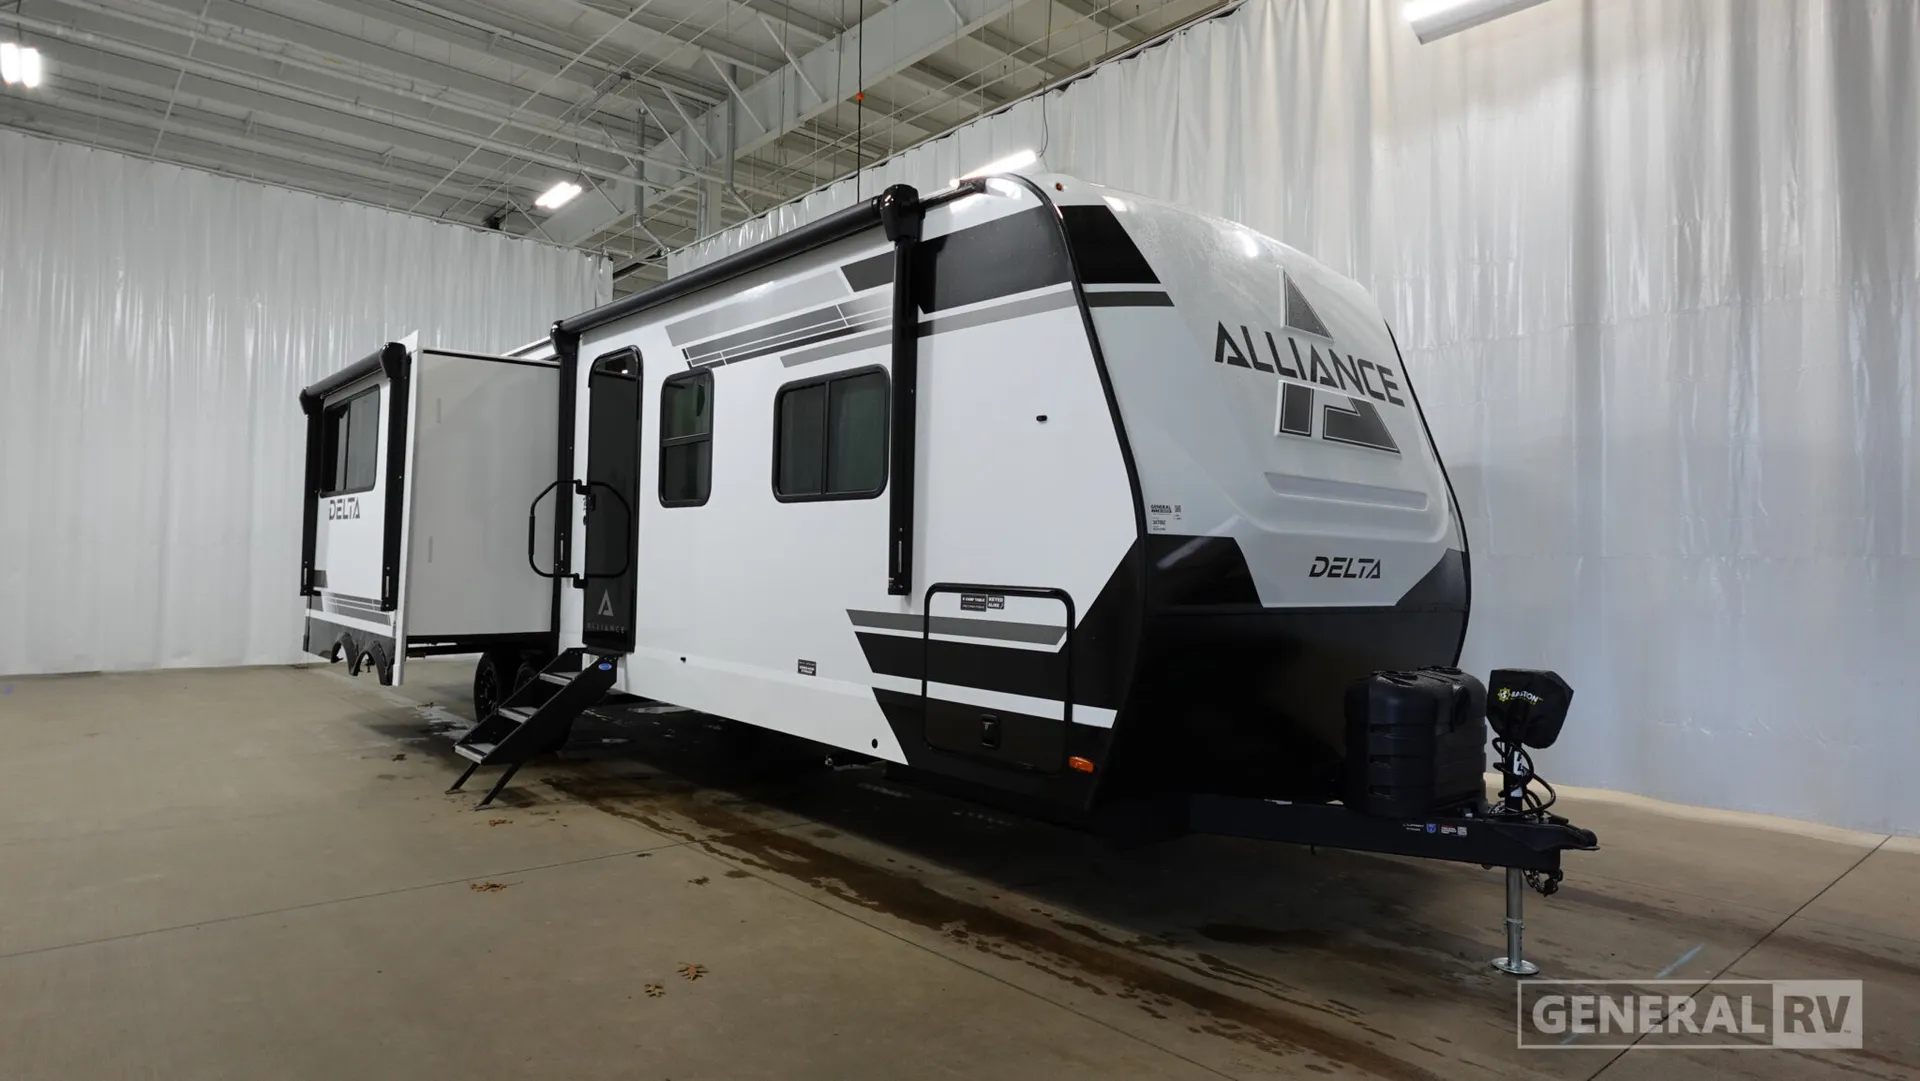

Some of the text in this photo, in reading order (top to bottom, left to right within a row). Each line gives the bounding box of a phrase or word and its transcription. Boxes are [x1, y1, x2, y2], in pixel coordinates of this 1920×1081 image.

[1214, 320, 1405, 408] ALLIANCE
[329, 496, 361, 521] DELTA
[1308, 555, 1381, 579] DELTA
